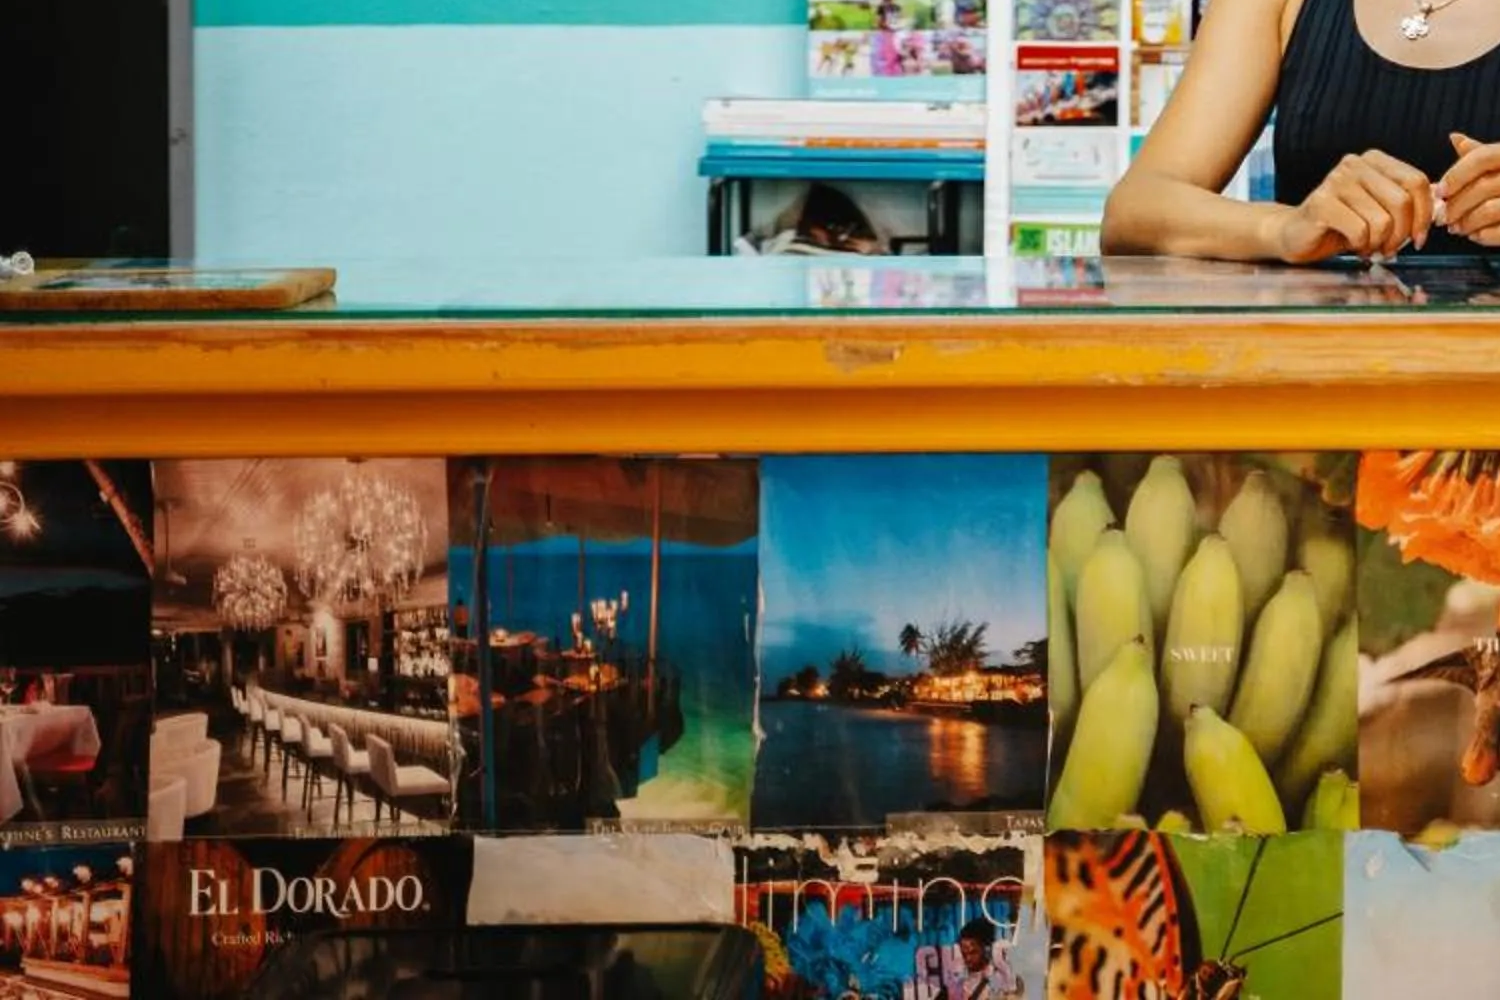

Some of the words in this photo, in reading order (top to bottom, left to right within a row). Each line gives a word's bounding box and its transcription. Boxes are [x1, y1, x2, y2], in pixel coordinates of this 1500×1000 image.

[1170, 645, 1234, 663] SWEET
[188, 868, 240, 916] EL
[251, 866, 424, 919] DORADO
[211, 930, 261, 947] Crafted
